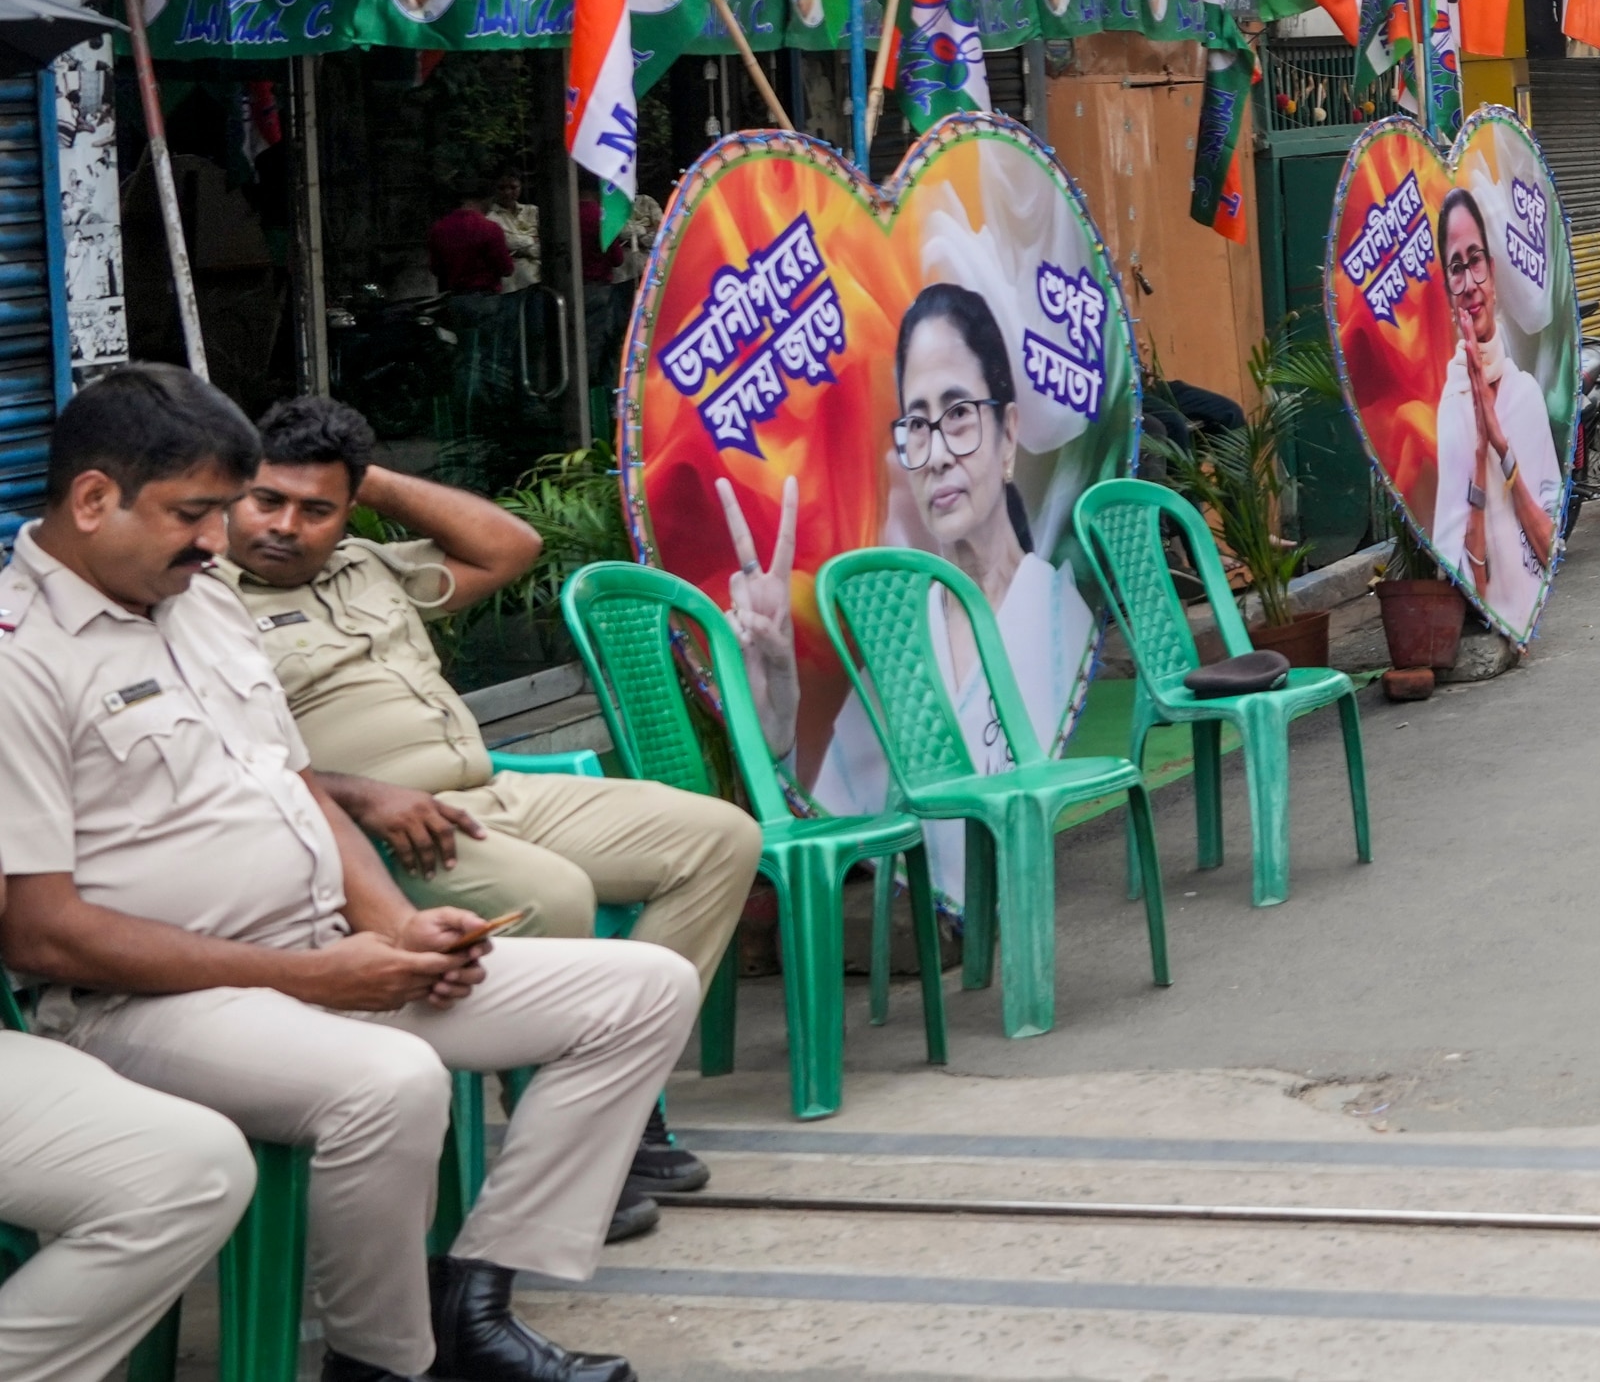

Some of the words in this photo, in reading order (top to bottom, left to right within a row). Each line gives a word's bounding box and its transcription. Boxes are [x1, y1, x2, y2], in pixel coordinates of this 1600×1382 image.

[1344, 176, 1420, 280] ভবানীপুরের
[1366, 258, 1406, 316] হৃদয়
[1400, 220, 1433, 277] জুড়ে
[1507, 229, 1545, 283] মমতা
[664, 223, 819, 386] ভবানীপুরের
[705, 350, 782, 440] হৃদয়
[774, 289, 841, 377] জুড়ে
[1027, 338, 1102, 413] মমতা
